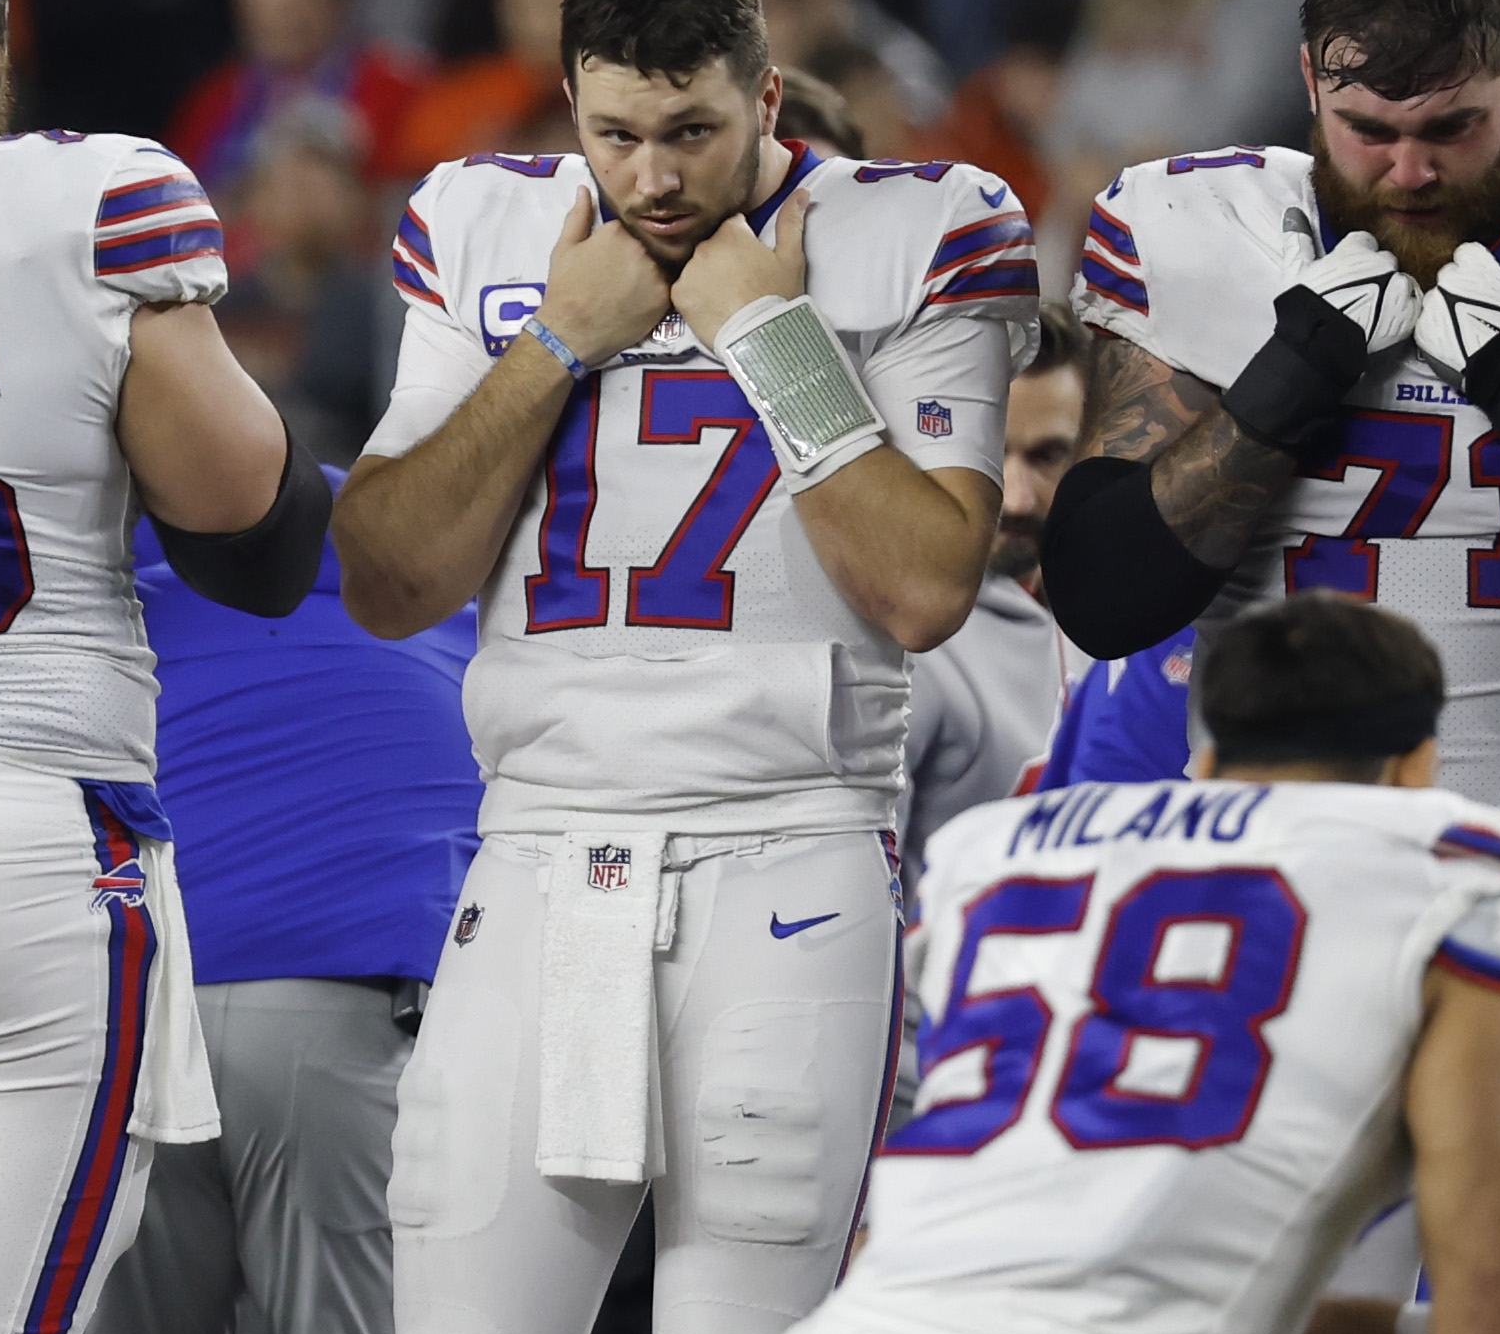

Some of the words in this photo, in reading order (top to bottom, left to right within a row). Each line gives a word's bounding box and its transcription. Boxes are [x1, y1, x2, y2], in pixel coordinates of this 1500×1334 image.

[920, 415, 949, 434] NFL
[523, 368, 782, 636] 17
[1007, 779, 1272, 858] MILANO
[591, 864, 628, 889] NFL
[876, 866, 1308, 1155] 58
